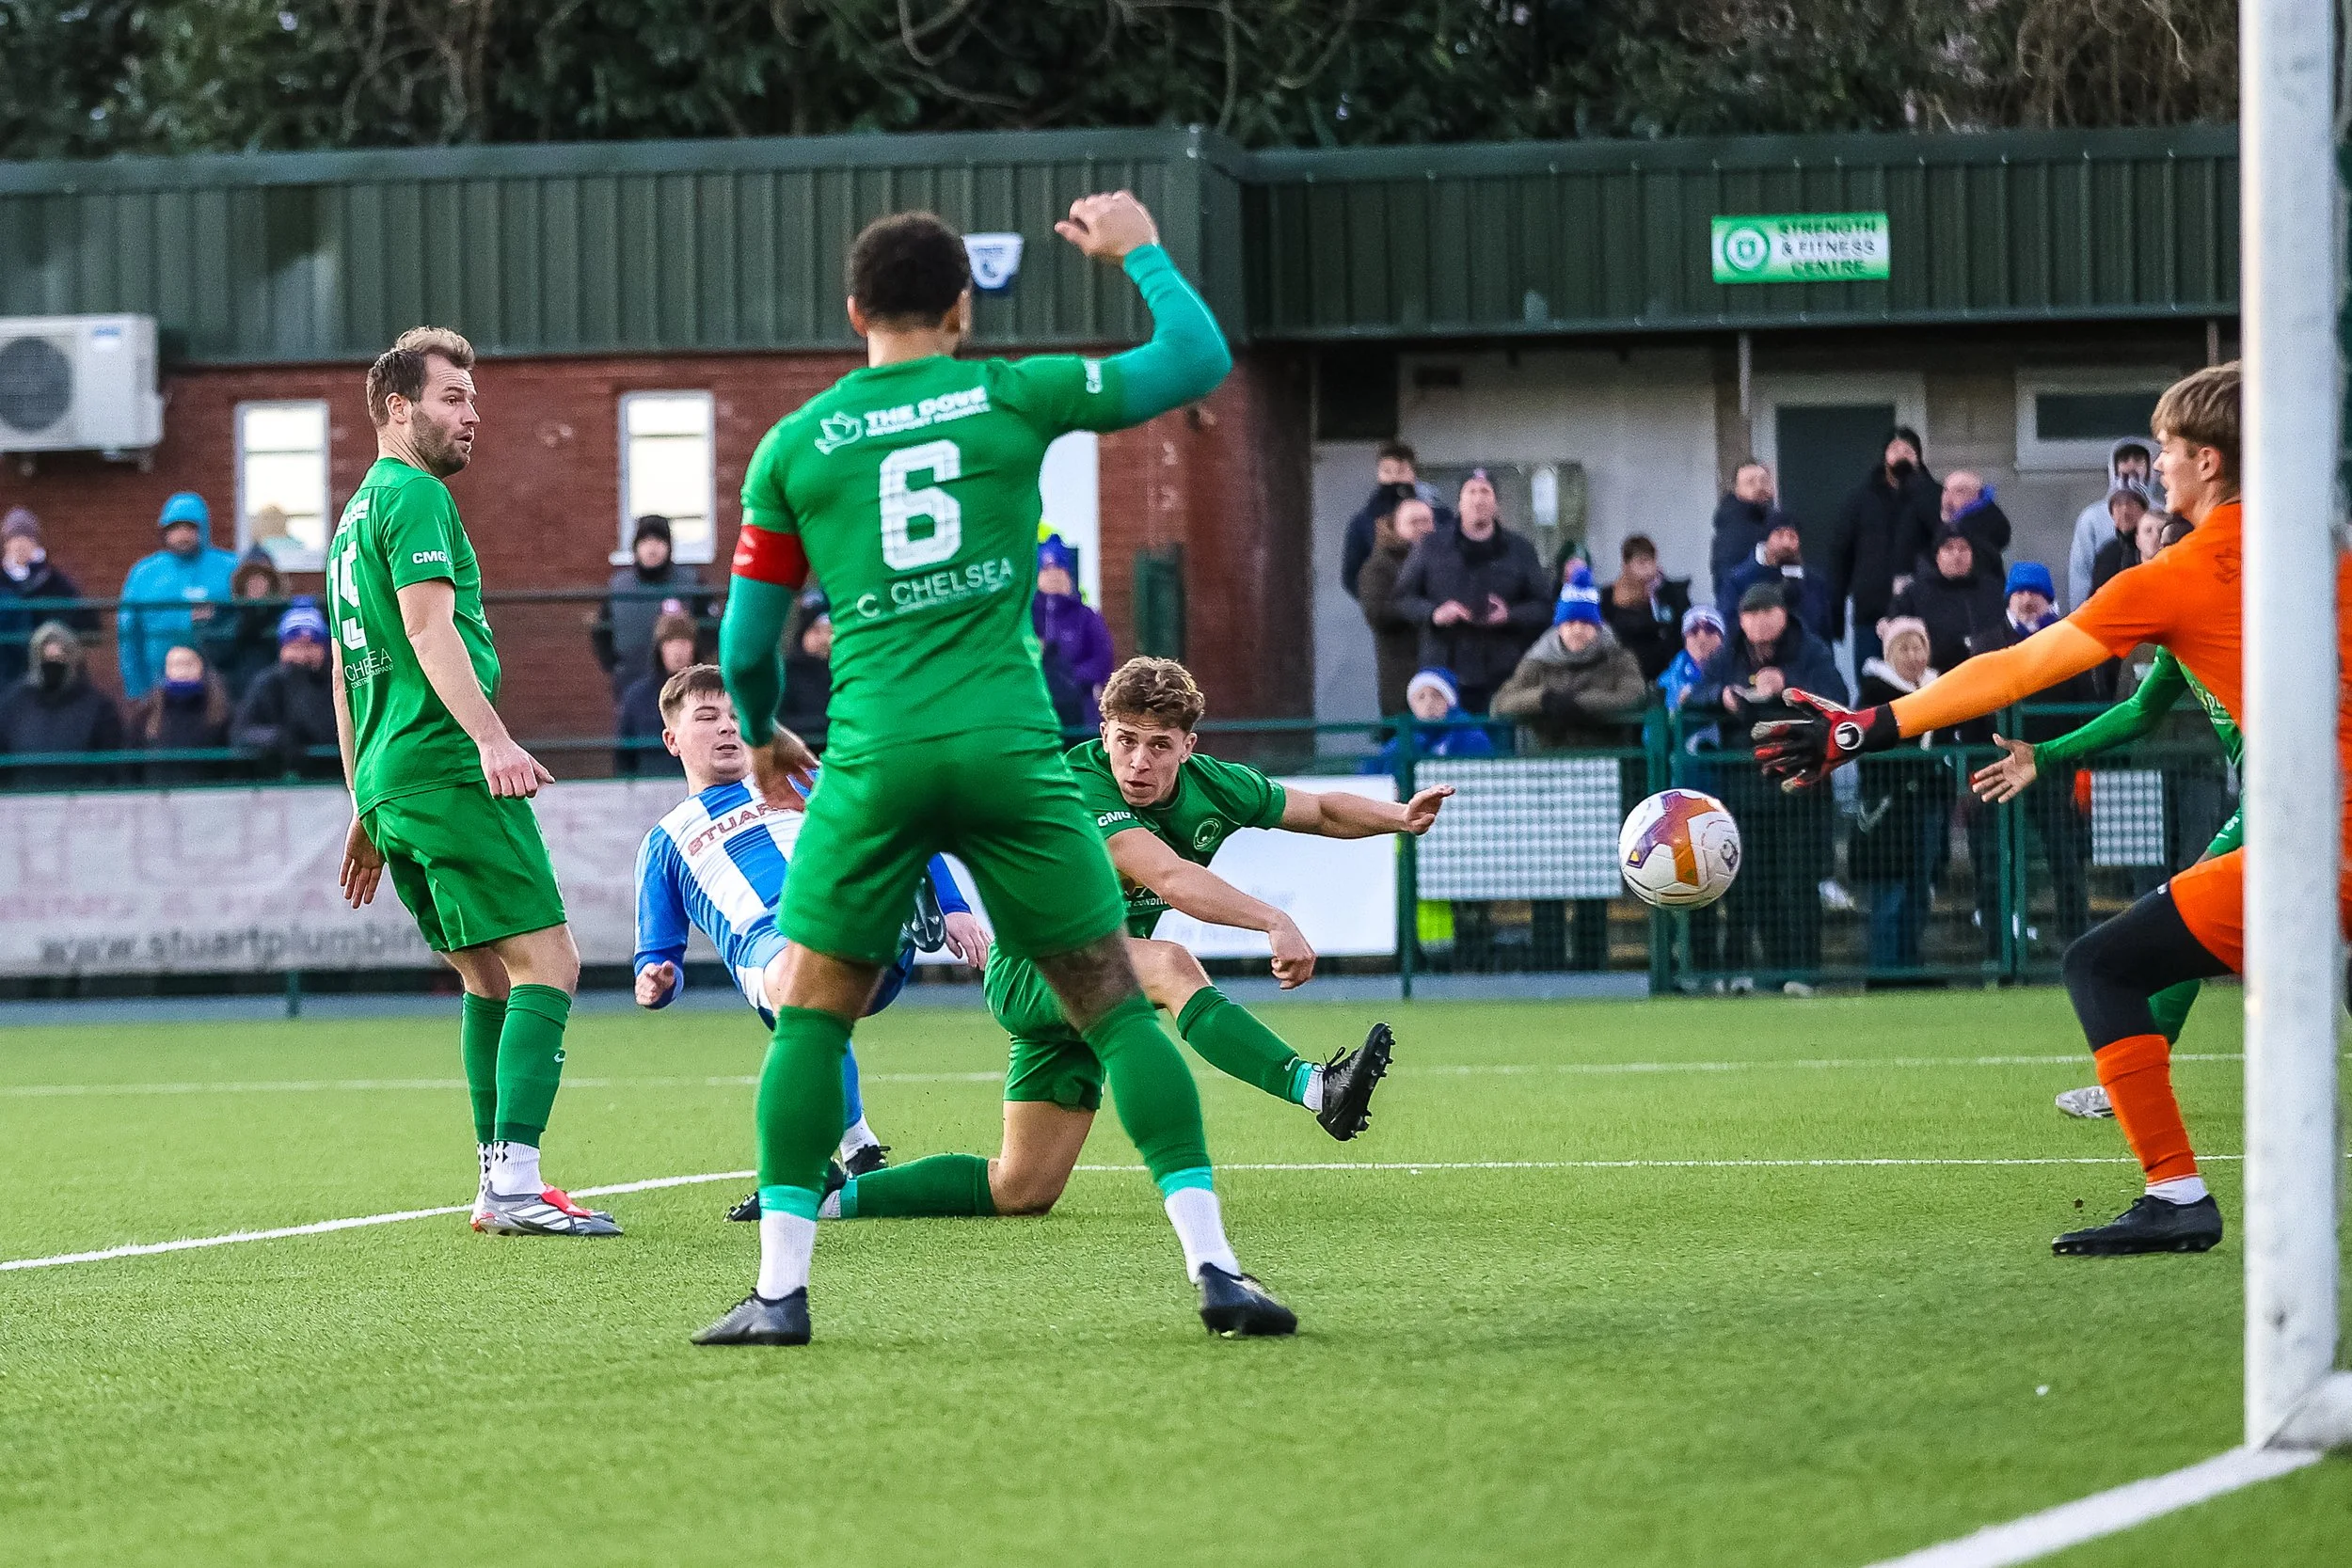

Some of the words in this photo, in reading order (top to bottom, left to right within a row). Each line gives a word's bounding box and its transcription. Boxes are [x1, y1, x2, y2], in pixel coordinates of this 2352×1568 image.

[1777, 220, 1877, 234] STRENGTH
[1798, 239, 1876, 256] FITNESS
[1790, 259, 1864, 277] CENTRE
[864, 404, 915, 429] THE
[879, 439, 961, 572] 6
[890, 557, 1014, 605] CHELSEA
[688, 802, 772, 856] STUAR
